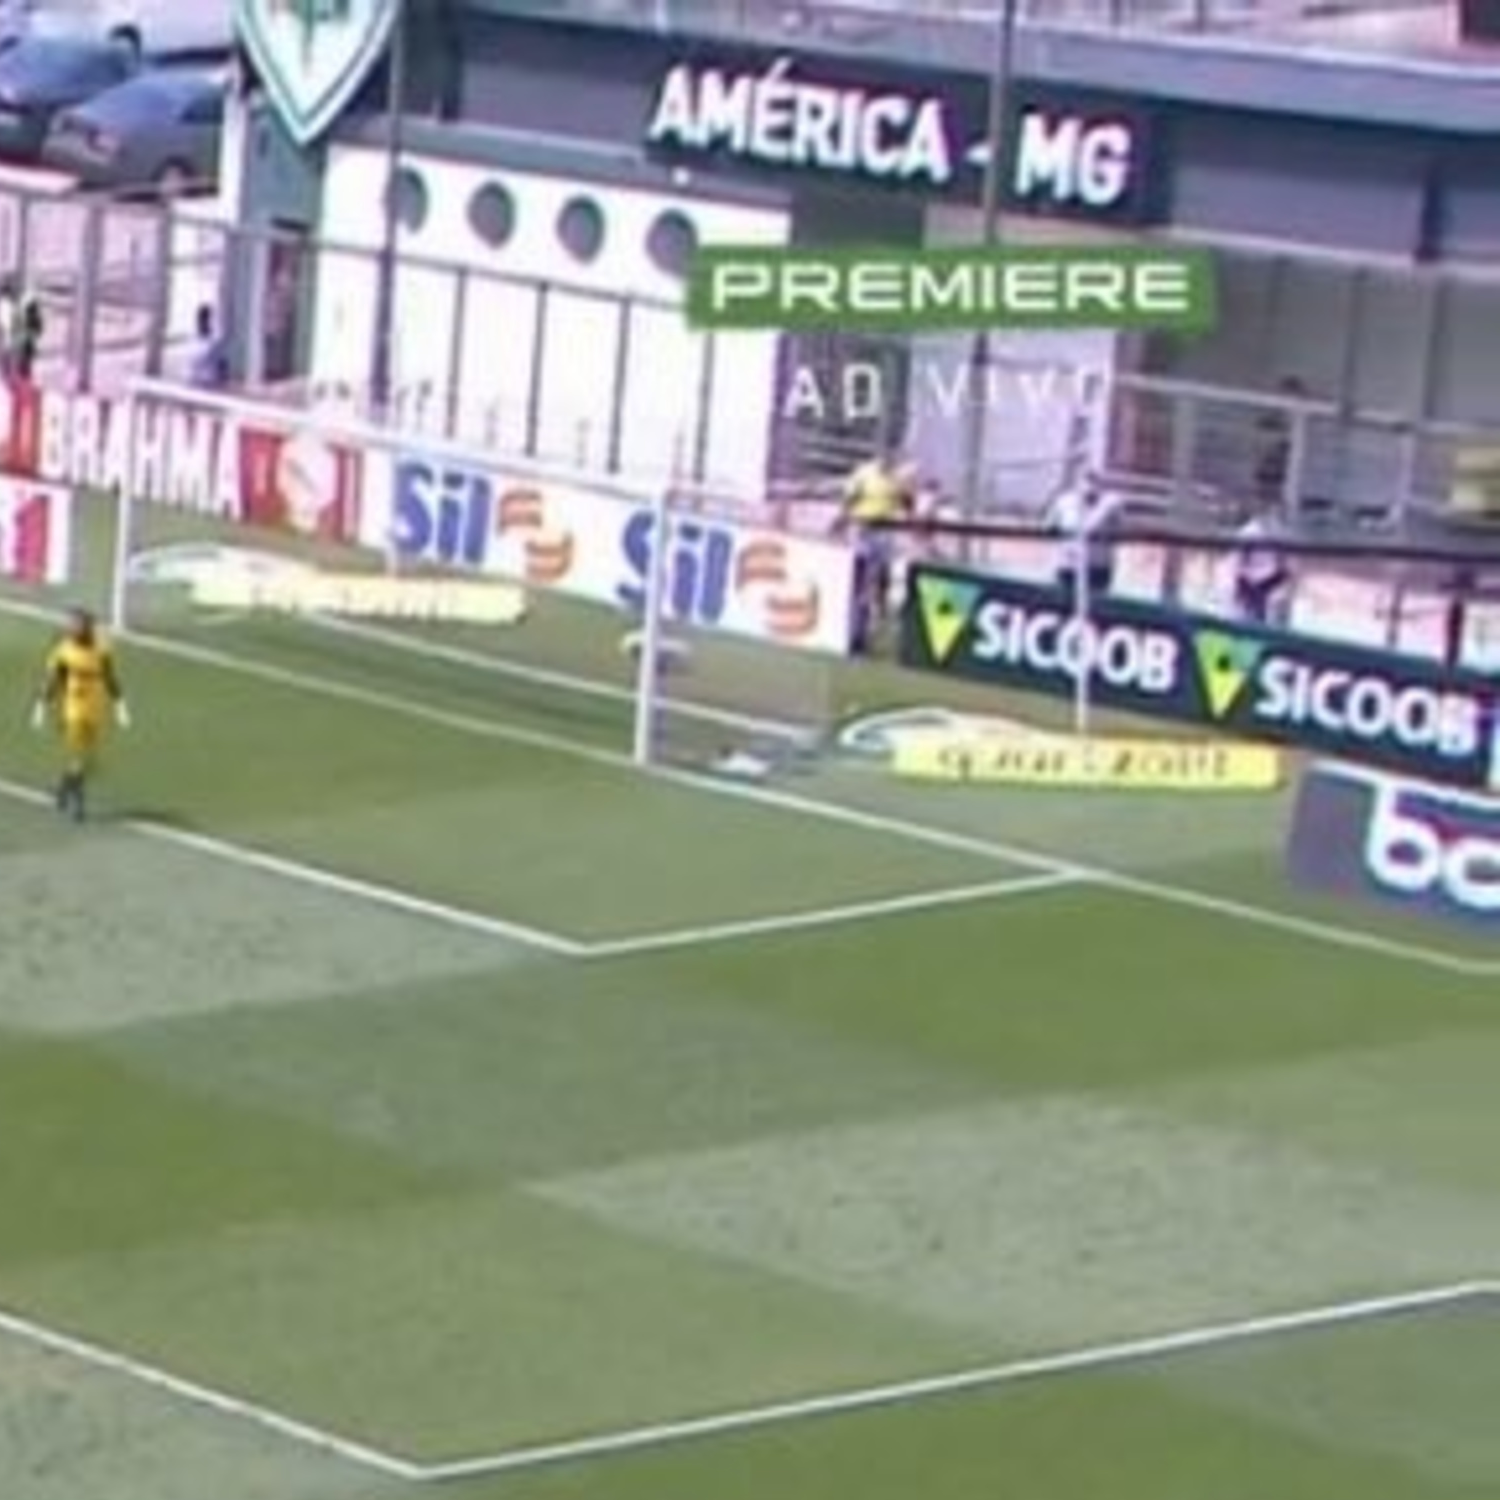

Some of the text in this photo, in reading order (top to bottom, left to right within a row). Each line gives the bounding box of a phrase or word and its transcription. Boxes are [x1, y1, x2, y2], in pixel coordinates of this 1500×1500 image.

[649, 57, 951, 182] AMÉRICA
[1015, 114, 1131, 205] MG
[39, 392, 242, 520] BRAHMA
[393, 459, 493, 566] Sil
[615, 509, 735, 625] Sil
[973, 600, 1180, 692] SICOOB
[1255, 656, 1482, 757] SICOOB
